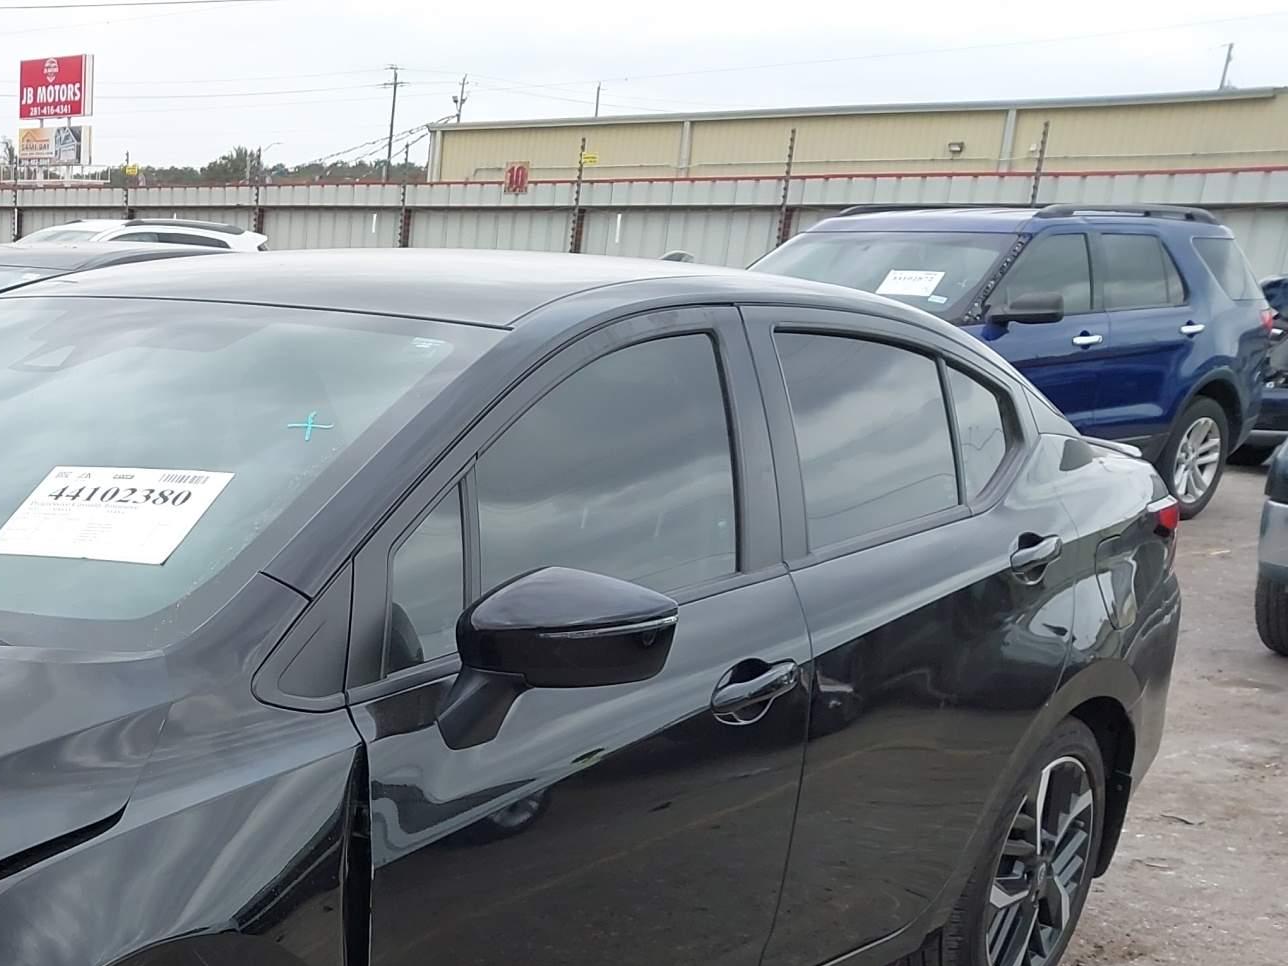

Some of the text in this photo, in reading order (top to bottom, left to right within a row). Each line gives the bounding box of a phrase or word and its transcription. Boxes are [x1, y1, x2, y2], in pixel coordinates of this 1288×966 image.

[22, 83, 80, 104] JB MOTORS
[30, 105, 70, 116] 281-416-4341
[48, 486, 191, 506] 44102380
